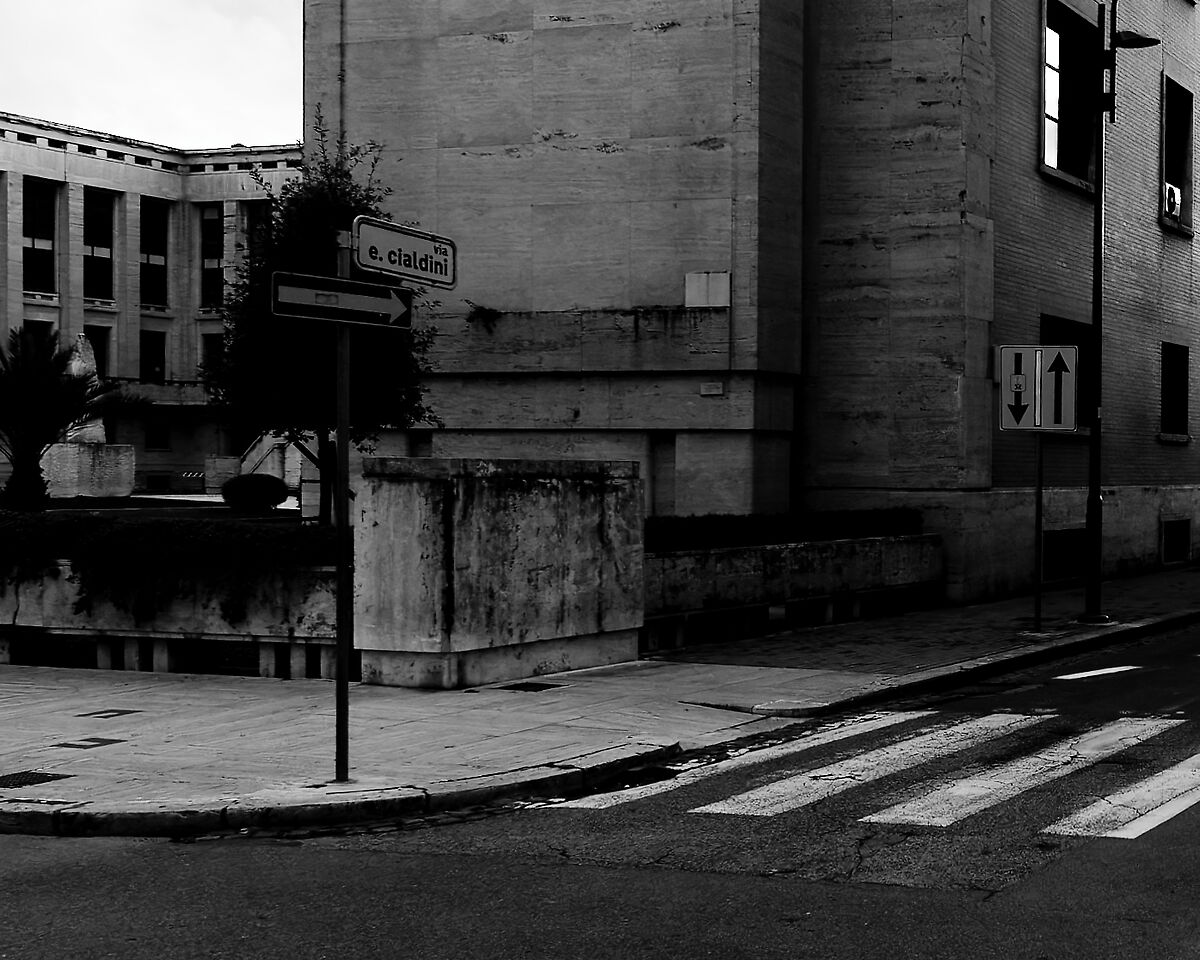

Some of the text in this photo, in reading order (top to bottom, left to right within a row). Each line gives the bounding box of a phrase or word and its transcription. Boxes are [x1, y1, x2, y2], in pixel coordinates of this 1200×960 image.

[368, 245, 448, 276] e. cialdini
[434, 243, 448, 256] via
